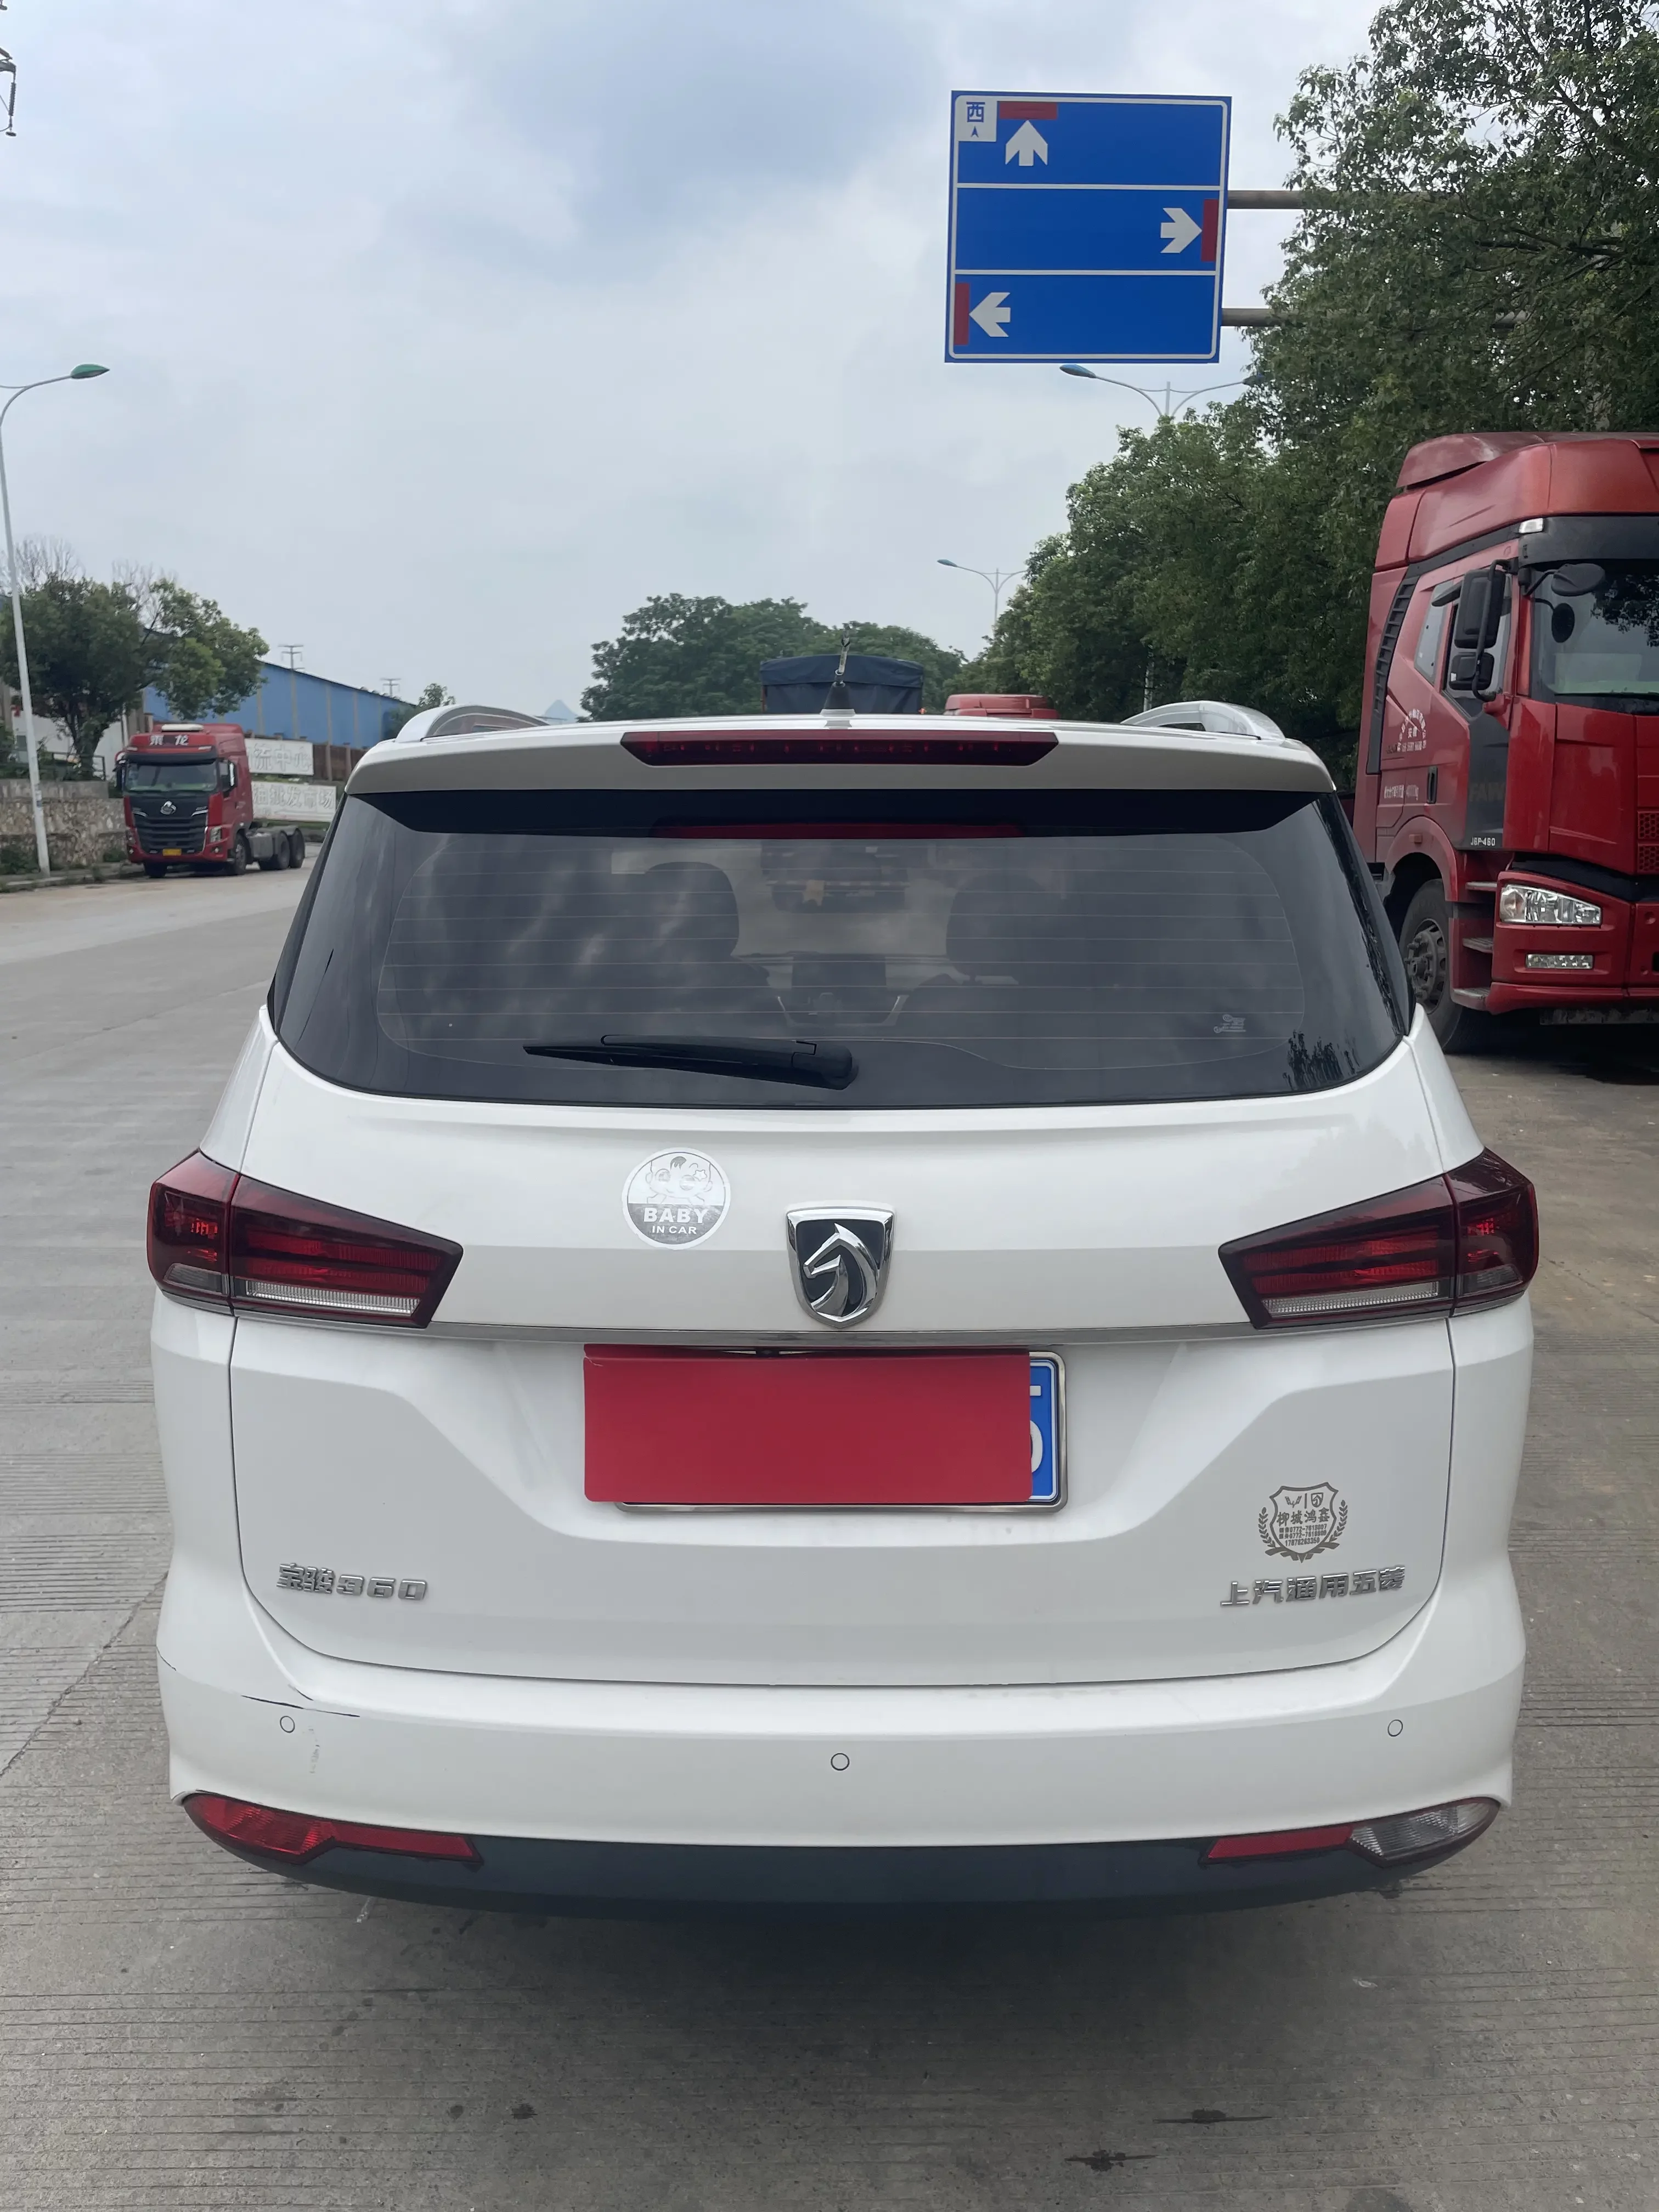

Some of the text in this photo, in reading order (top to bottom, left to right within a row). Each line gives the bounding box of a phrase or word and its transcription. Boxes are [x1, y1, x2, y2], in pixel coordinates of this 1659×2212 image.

[966, 101, 986, 123] 西
[247, 743, 312, 772] 流中心
[644, 1207, 708, 1223] BABY
[652, 1226, 697, 1234] IN CAR
[1220, 1565, 1406, 1607] 上汽通用五菱
